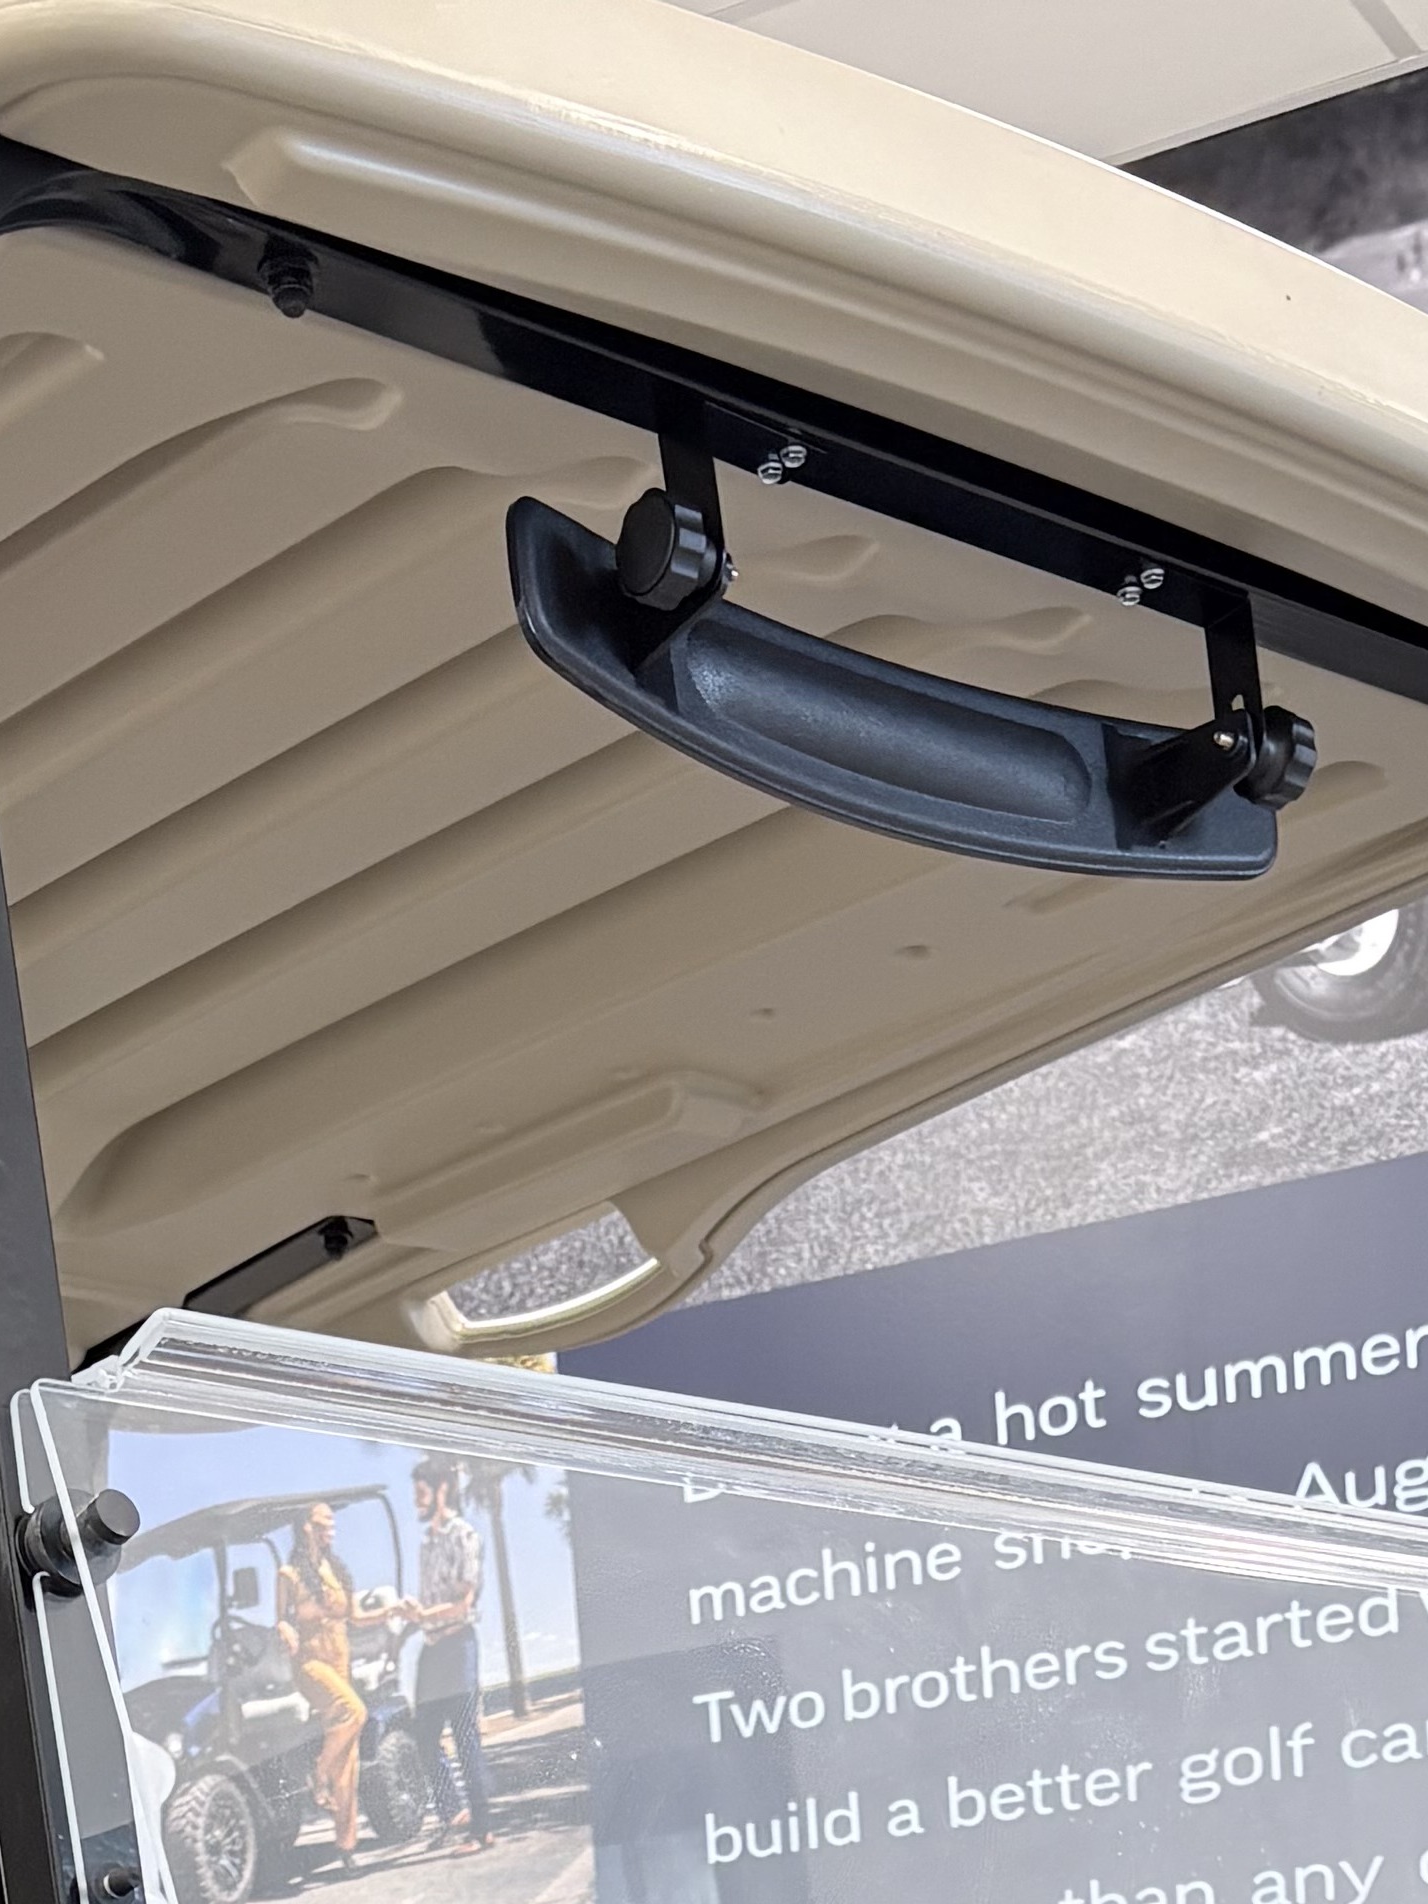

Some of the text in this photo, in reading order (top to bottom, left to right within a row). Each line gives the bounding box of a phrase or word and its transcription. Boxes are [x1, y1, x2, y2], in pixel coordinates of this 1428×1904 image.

[993, 1379, 1107, 1446] hot
[687, 1541, 963, 1625] machine
[691, 1689, 826, 1744] Two
[840, 1640, 1129, 1722] brothers
[1144, 1586, 1400, 1672] started
[704, 1790, 861, 1865] build
[886, 1797, 925, 1838] a
[946, 1761, 1153, 1829] better
[1178, 1721, 1316, 1805] golf
